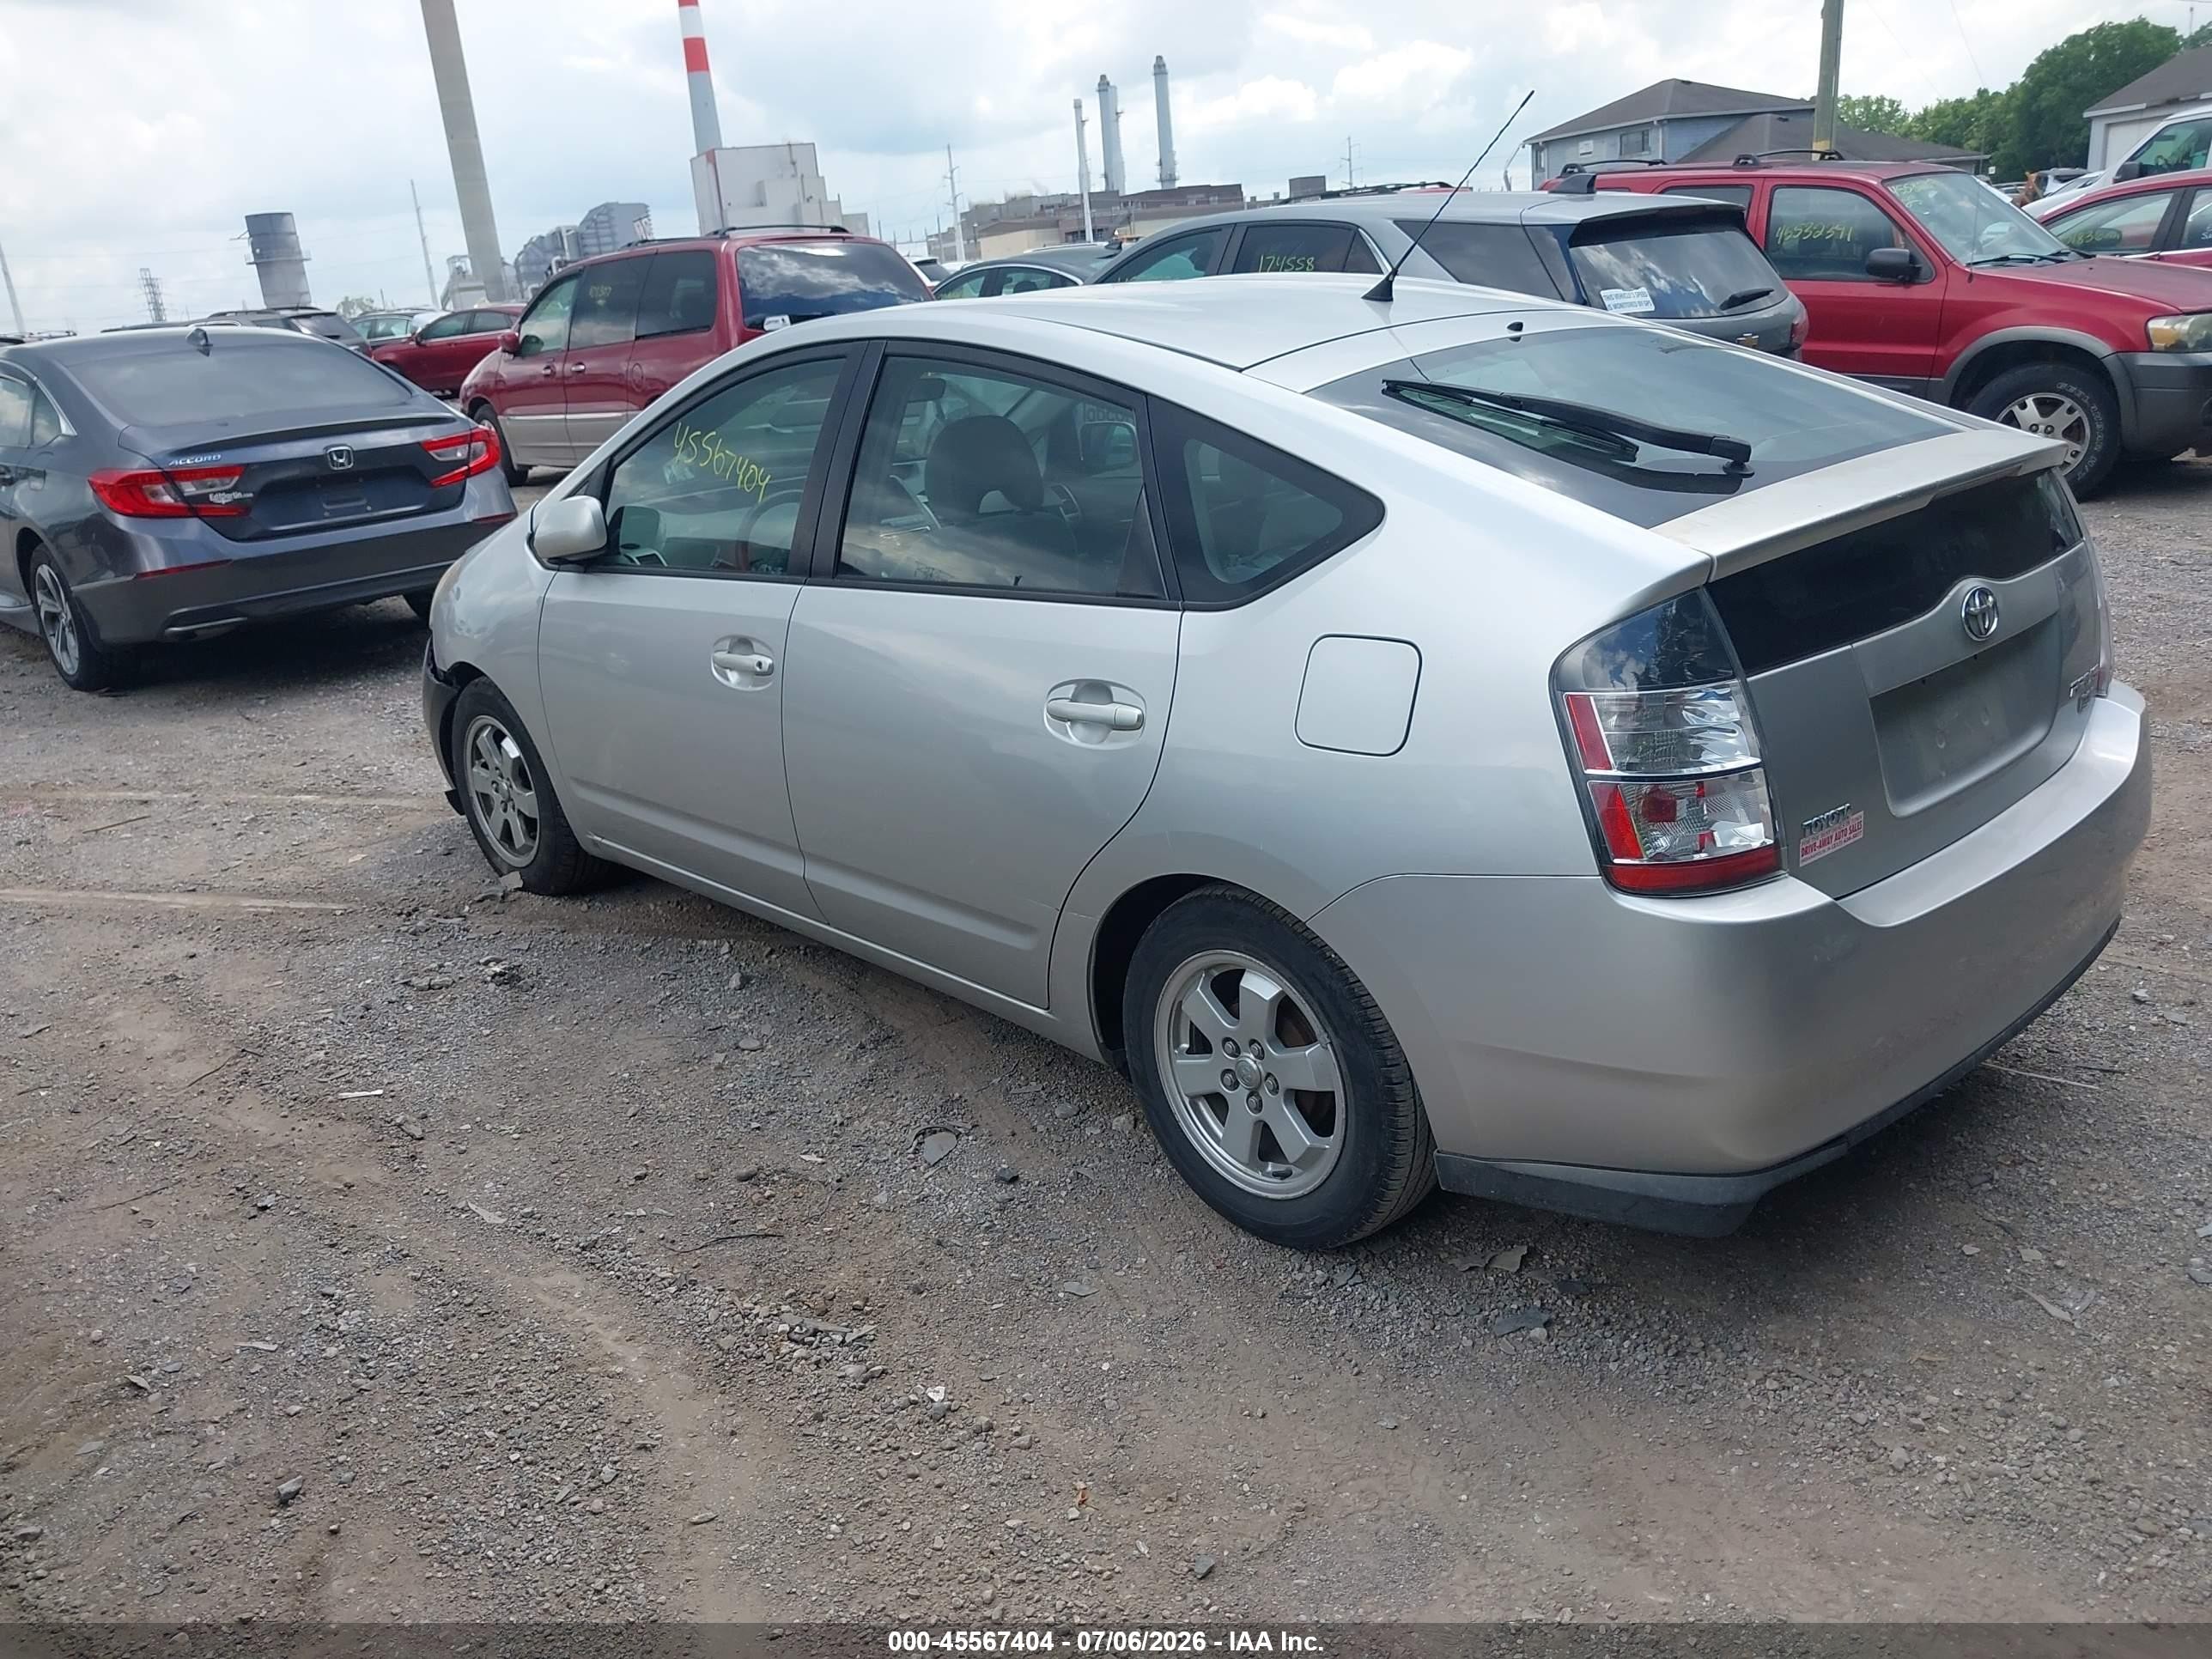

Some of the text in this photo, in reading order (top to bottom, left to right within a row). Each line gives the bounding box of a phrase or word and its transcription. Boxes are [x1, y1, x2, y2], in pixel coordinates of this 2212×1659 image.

[1258, 254, 1315, 273] 174558
[168, 454, 222, 466] ACCORD
[675, 422, 771, 502] 45567404
[1801, 836, 1834, 858] DRIVE-AWAY
[1834, 828, 1848, 842] AUTO
[1849, 820, 1863, 835] SALES
